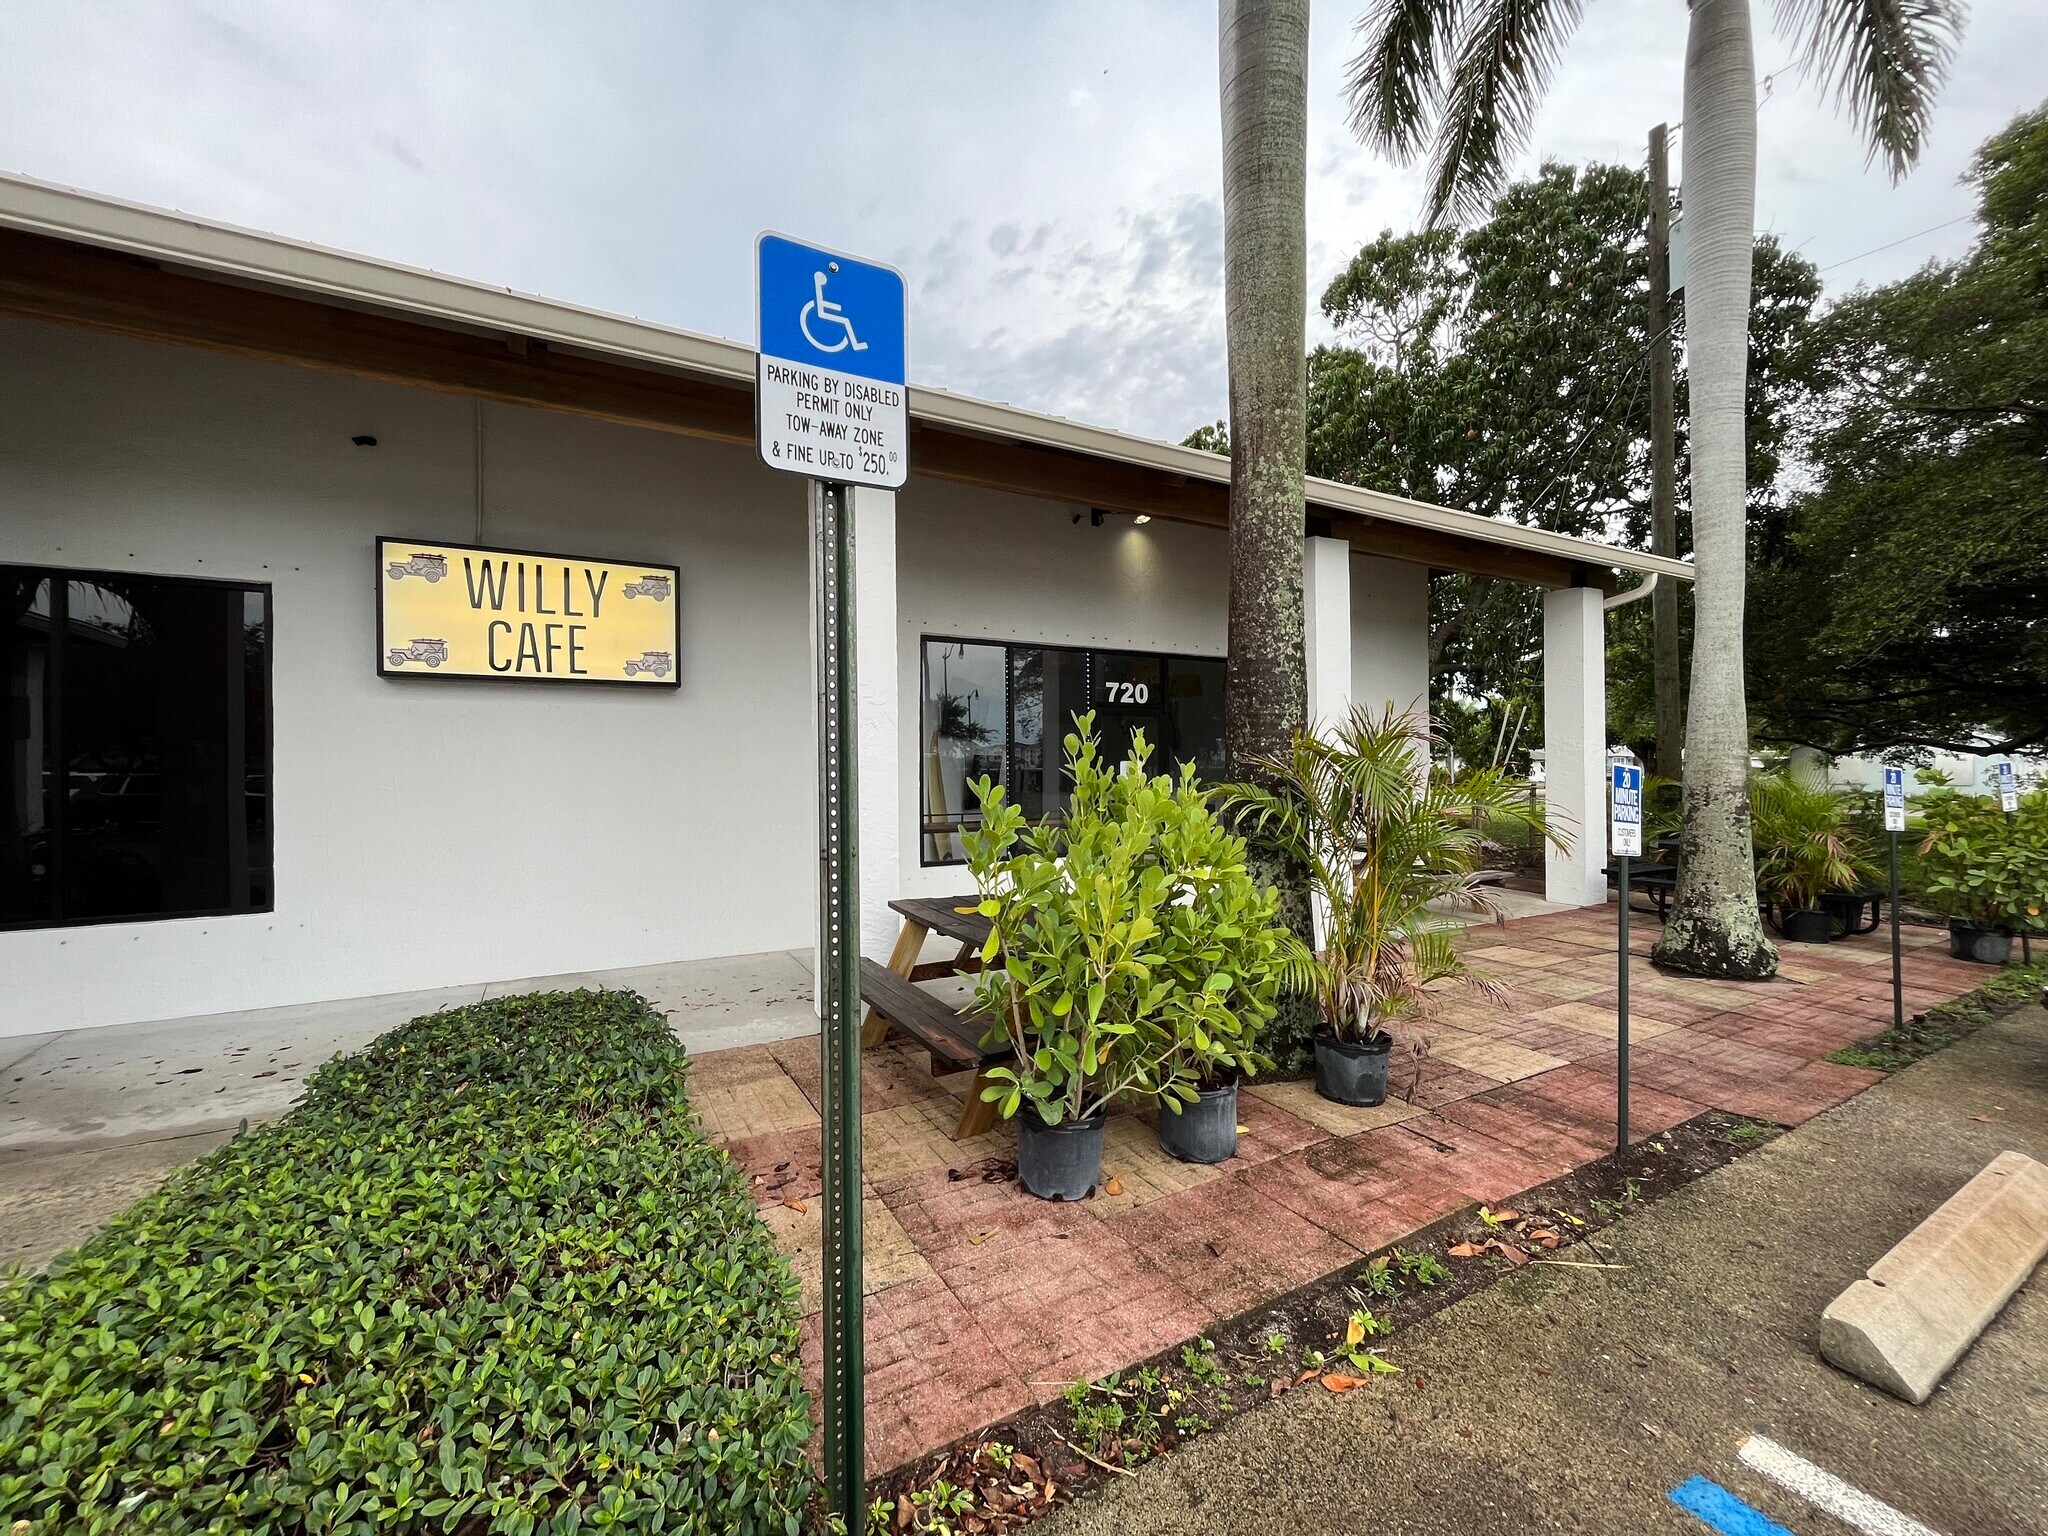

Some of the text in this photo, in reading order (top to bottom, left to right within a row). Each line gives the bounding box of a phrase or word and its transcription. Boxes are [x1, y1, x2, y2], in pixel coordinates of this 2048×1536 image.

[767, 364, 899, 407] PARKING BY DISABLED
[796, 391, 873, 422] PERMIT ONLY
[785, 413, 884, 447] TOW-AWAY ZONE
[772, 440, 780, 458] &
[787, 443, 813, 464] FINE
[819, 449, 835, 467] UP
[839, 452, 854, 470] TO
[463, 557, 608, 618] WILLY
[488, 620, 588, 674] CAFE
[1105, 682, 1149, 704] 720
[1614, 803, 1639, 822] PARKING
